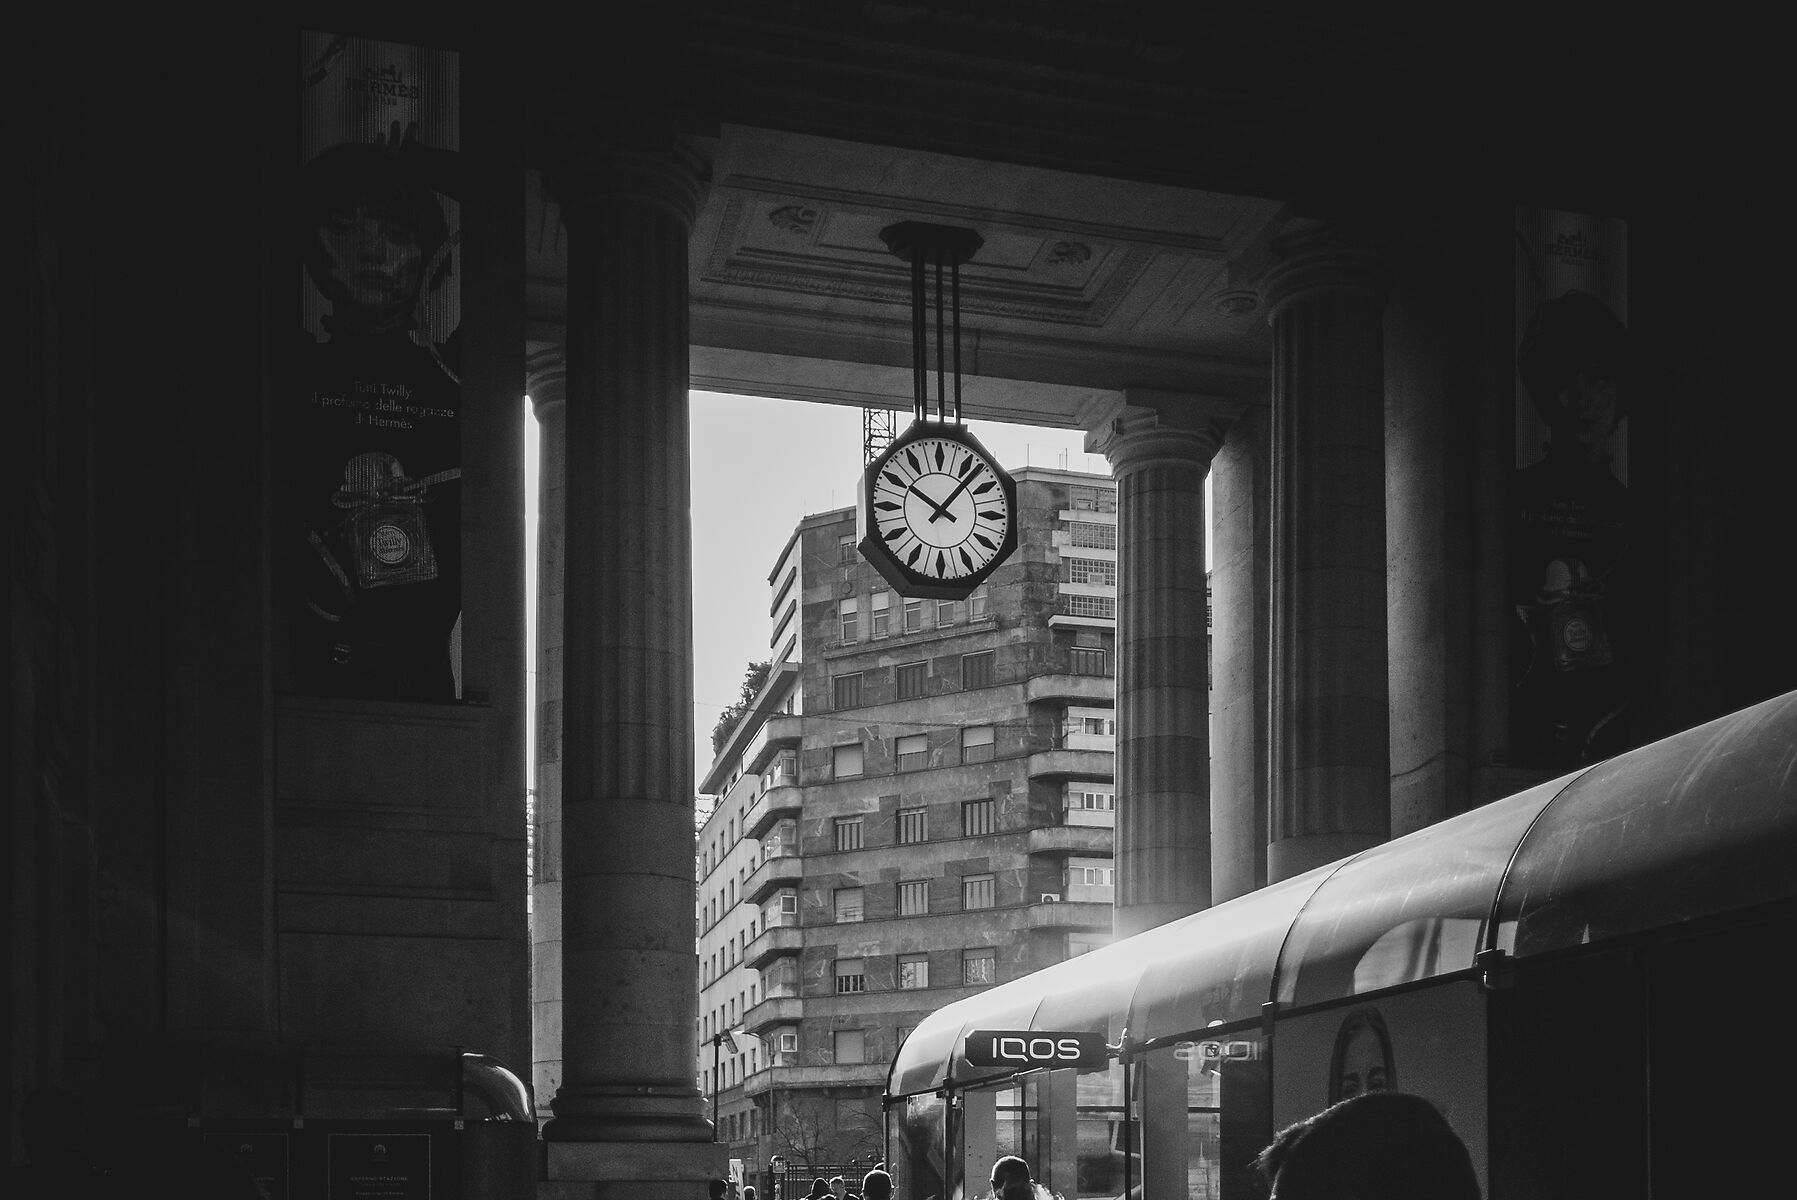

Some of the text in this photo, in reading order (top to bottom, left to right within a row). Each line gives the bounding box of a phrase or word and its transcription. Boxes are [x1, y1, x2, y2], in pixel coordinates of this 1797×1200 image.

[380, 383, 413, 401] Twilly
[375, 398, 403, 413] delle
[406, 406, 455, 419] ragazze
[992, 1036, 1081, 1062] IQOS
